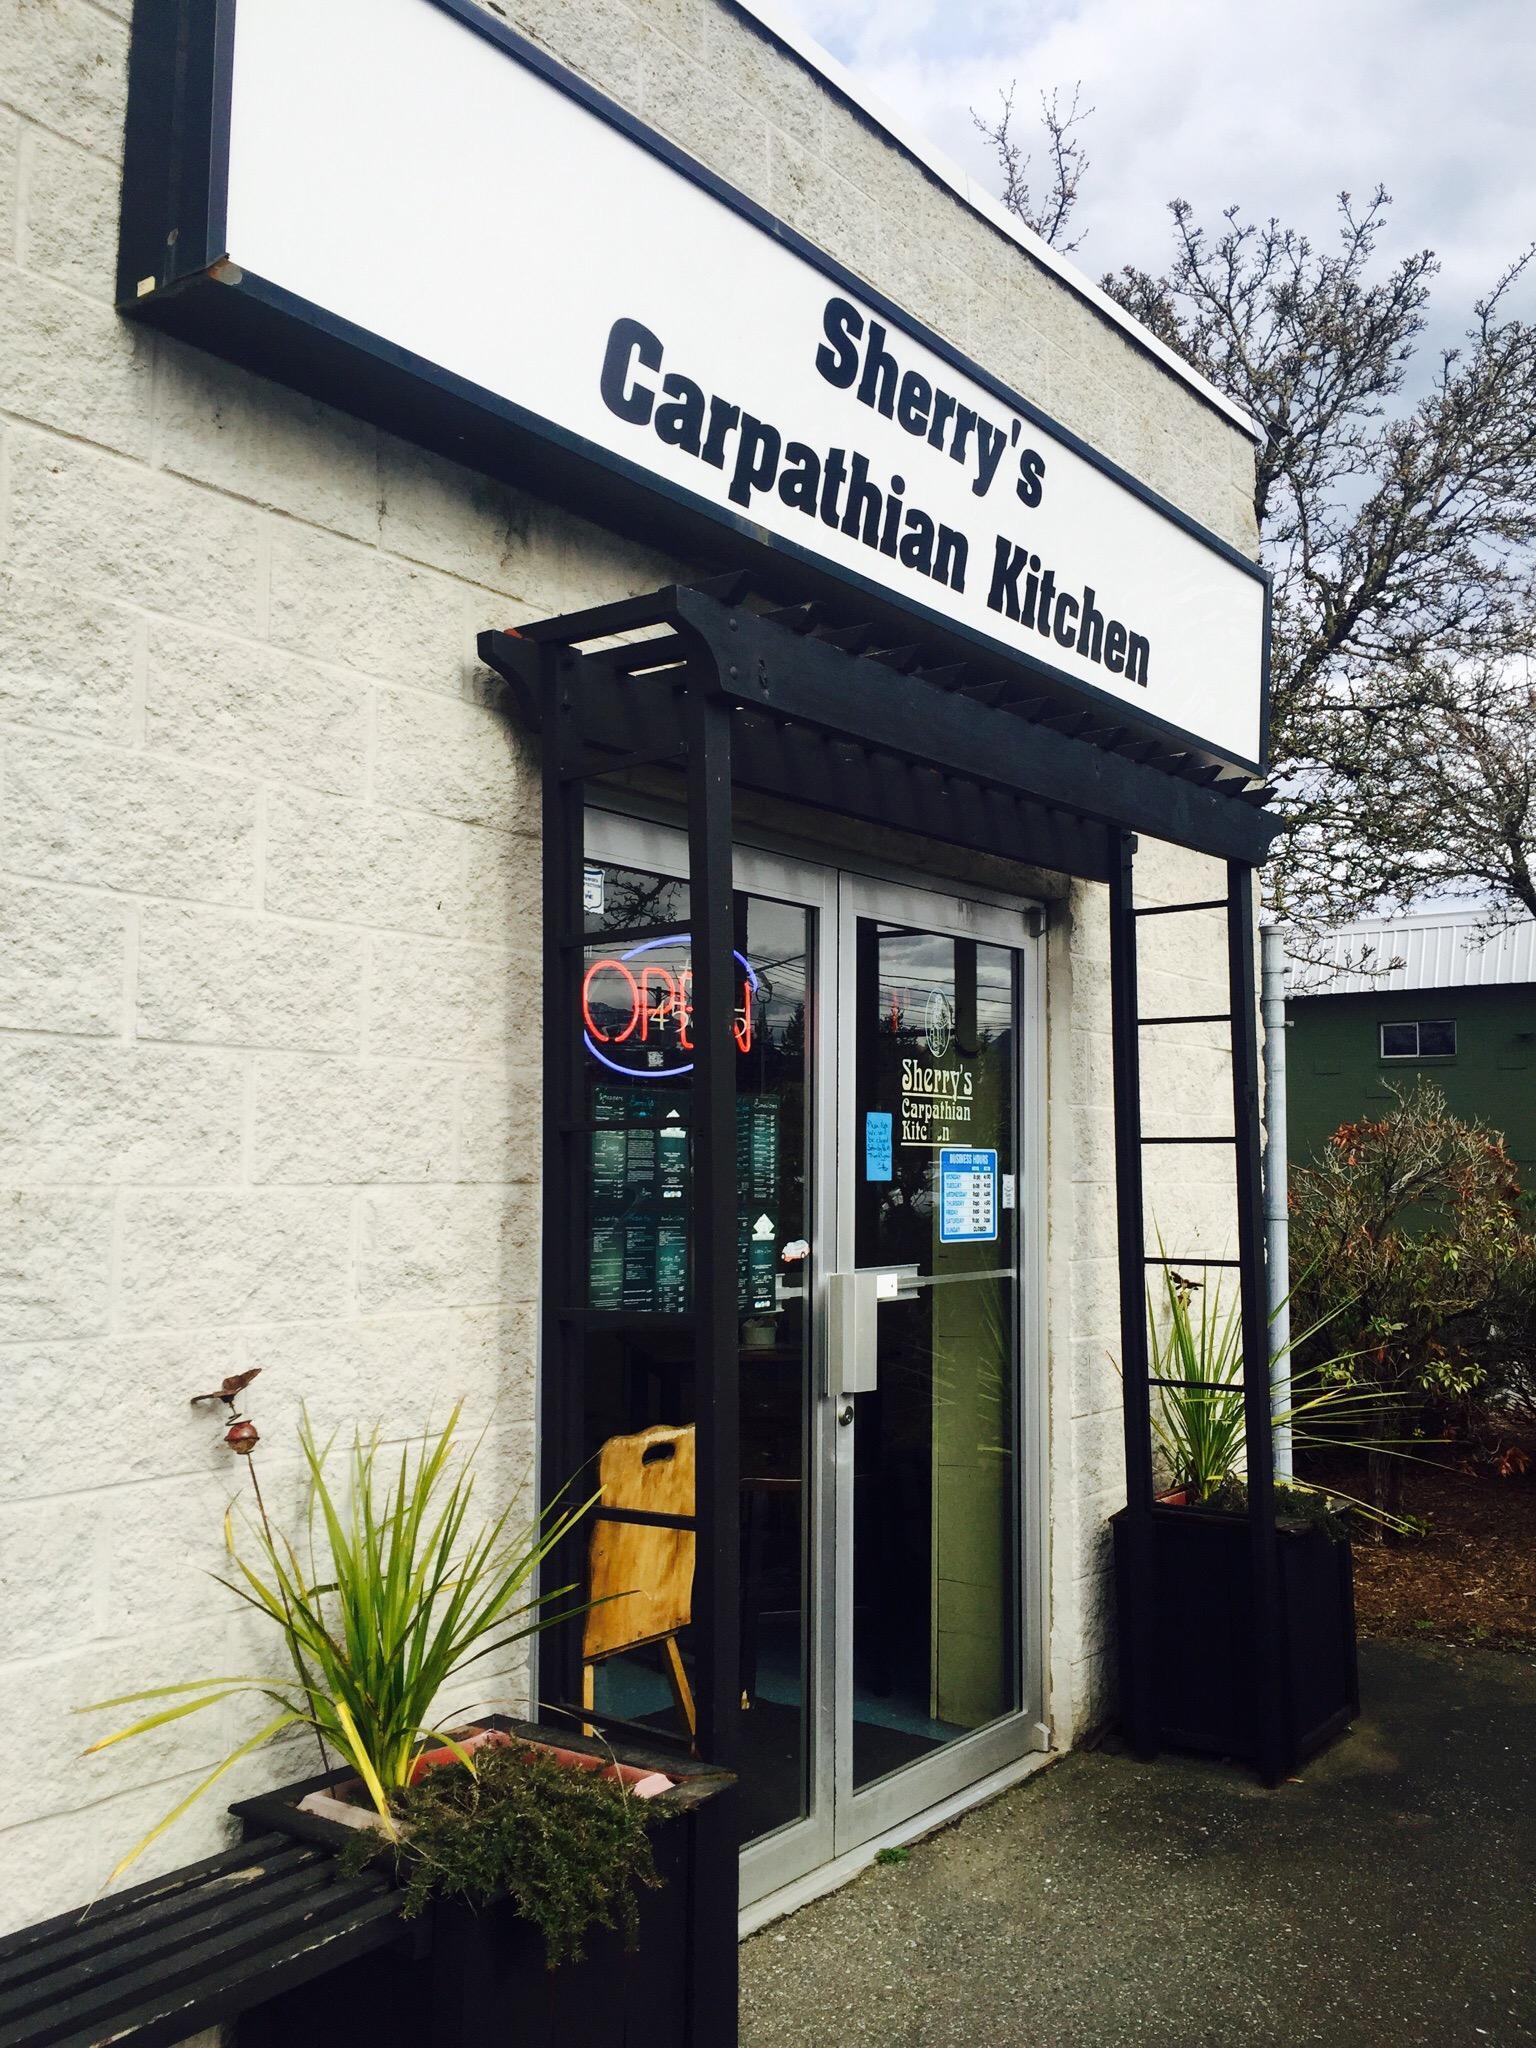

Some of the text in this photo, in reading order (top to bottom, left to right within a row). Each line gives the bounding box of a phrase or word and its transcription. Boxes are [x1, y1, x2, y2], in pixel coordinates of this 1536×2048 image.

[816, 297, 1046, 508] Sherry's
[600, 317, 1150, 688] Carpathian Kitchen
[902, 1058, 973, 1102] Sherry's
[901, 1098, 971, 1123] Carpathian
[901, 1120, 950, 1141] Kitcn
